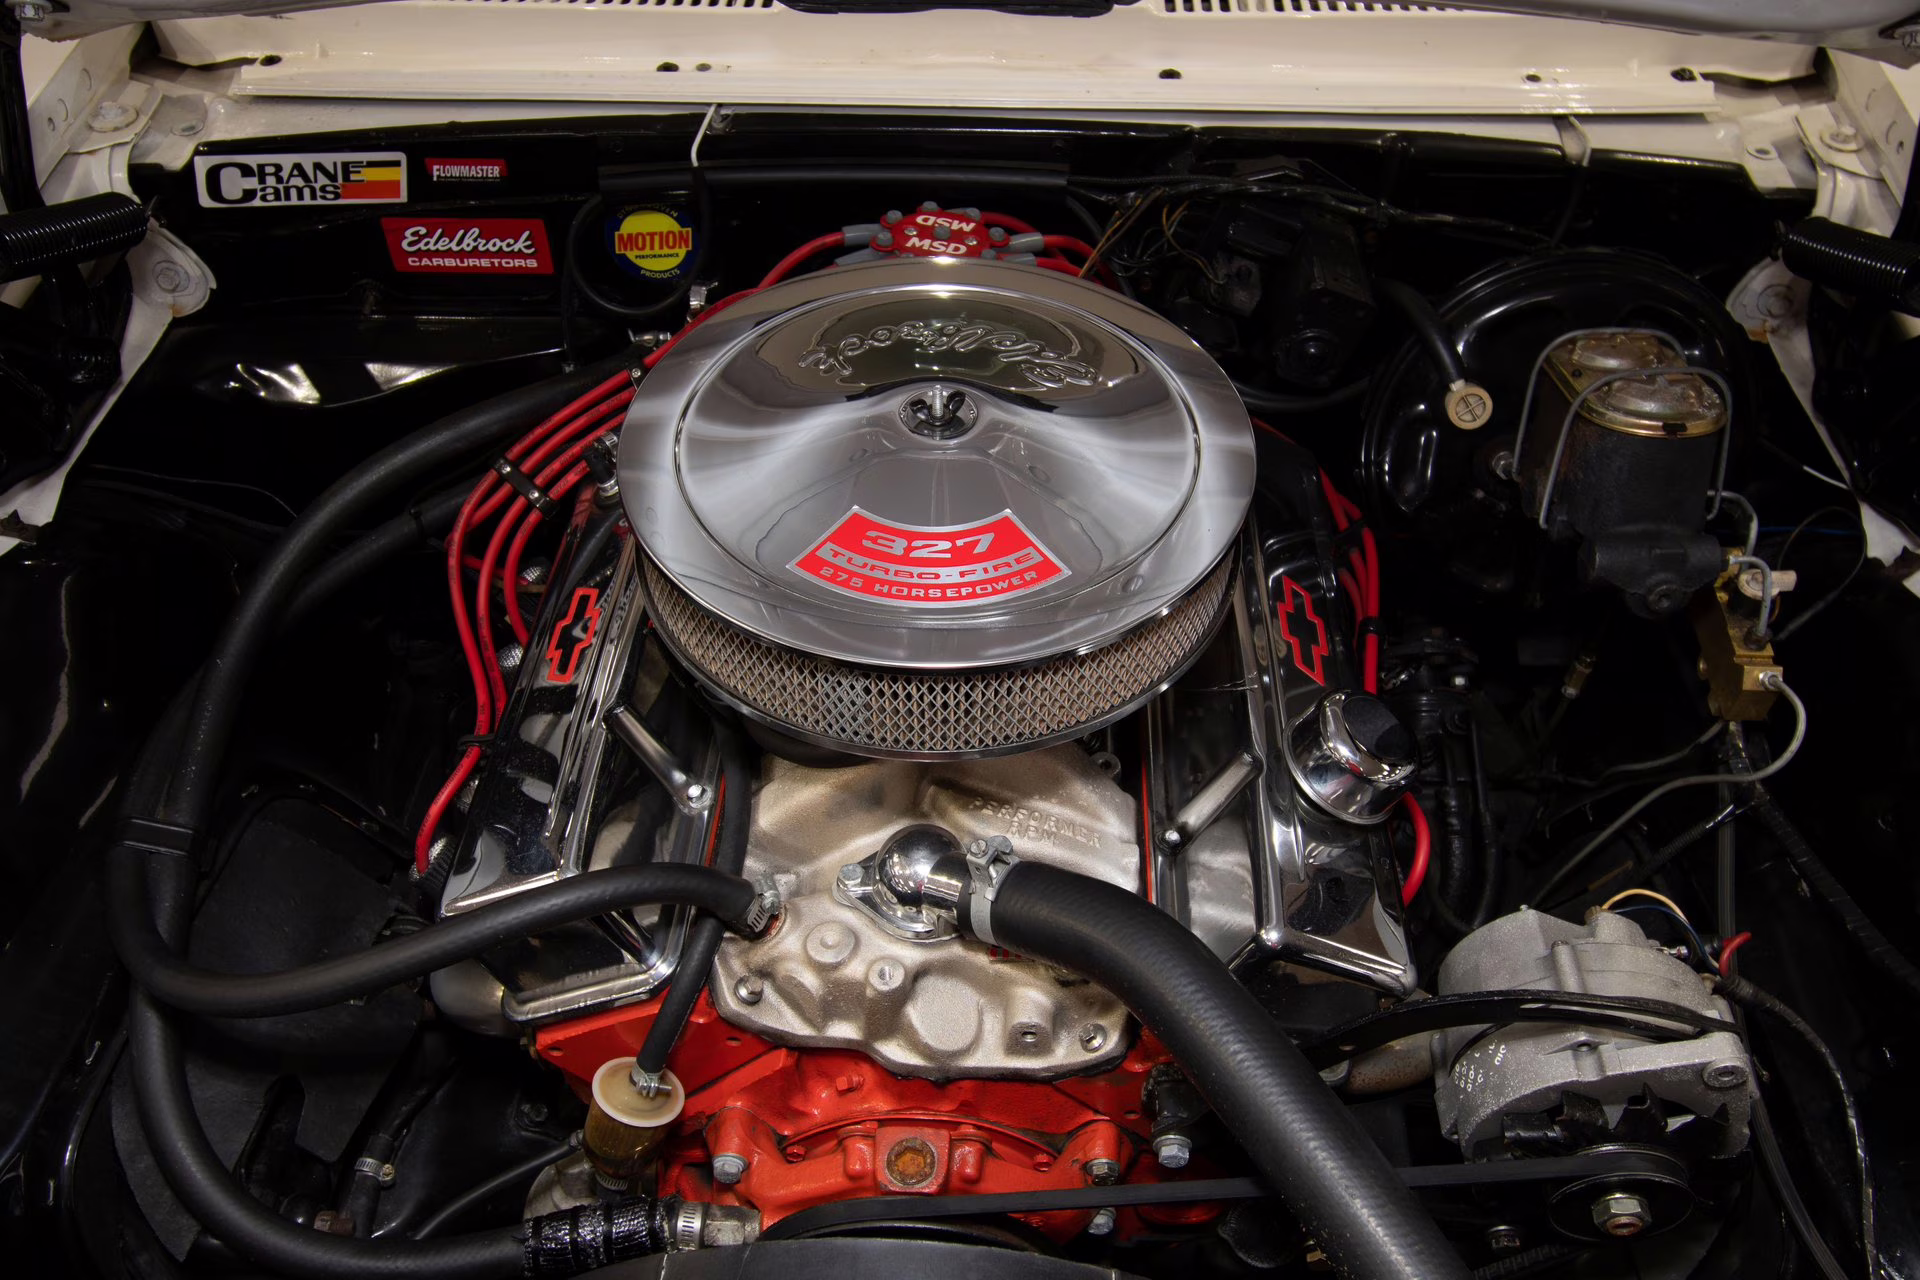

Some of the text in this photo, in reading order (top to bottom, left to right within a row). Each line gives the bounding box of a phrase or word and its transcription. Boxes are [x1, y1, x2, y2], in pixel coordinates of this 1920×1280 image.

[205, 160, 366, 204] CRANE
[432, 164, 501, 181] FLOWMASTER
[401, 225, 536, 254] Edelbrock
[617, 230, 690, 252] MOTION
[905, 236, 968, 255] MSD
[408, 257, 539, 268] CARBURETORS
[640, 268, 681, 279] PRODUCTS
[861, 530, 995, 558] 327
[819, 566, 864, 588] 275
[873, 570, 1039, 598] HORSEPOWER
[968, 797, 1102, 849] PERFORMER
